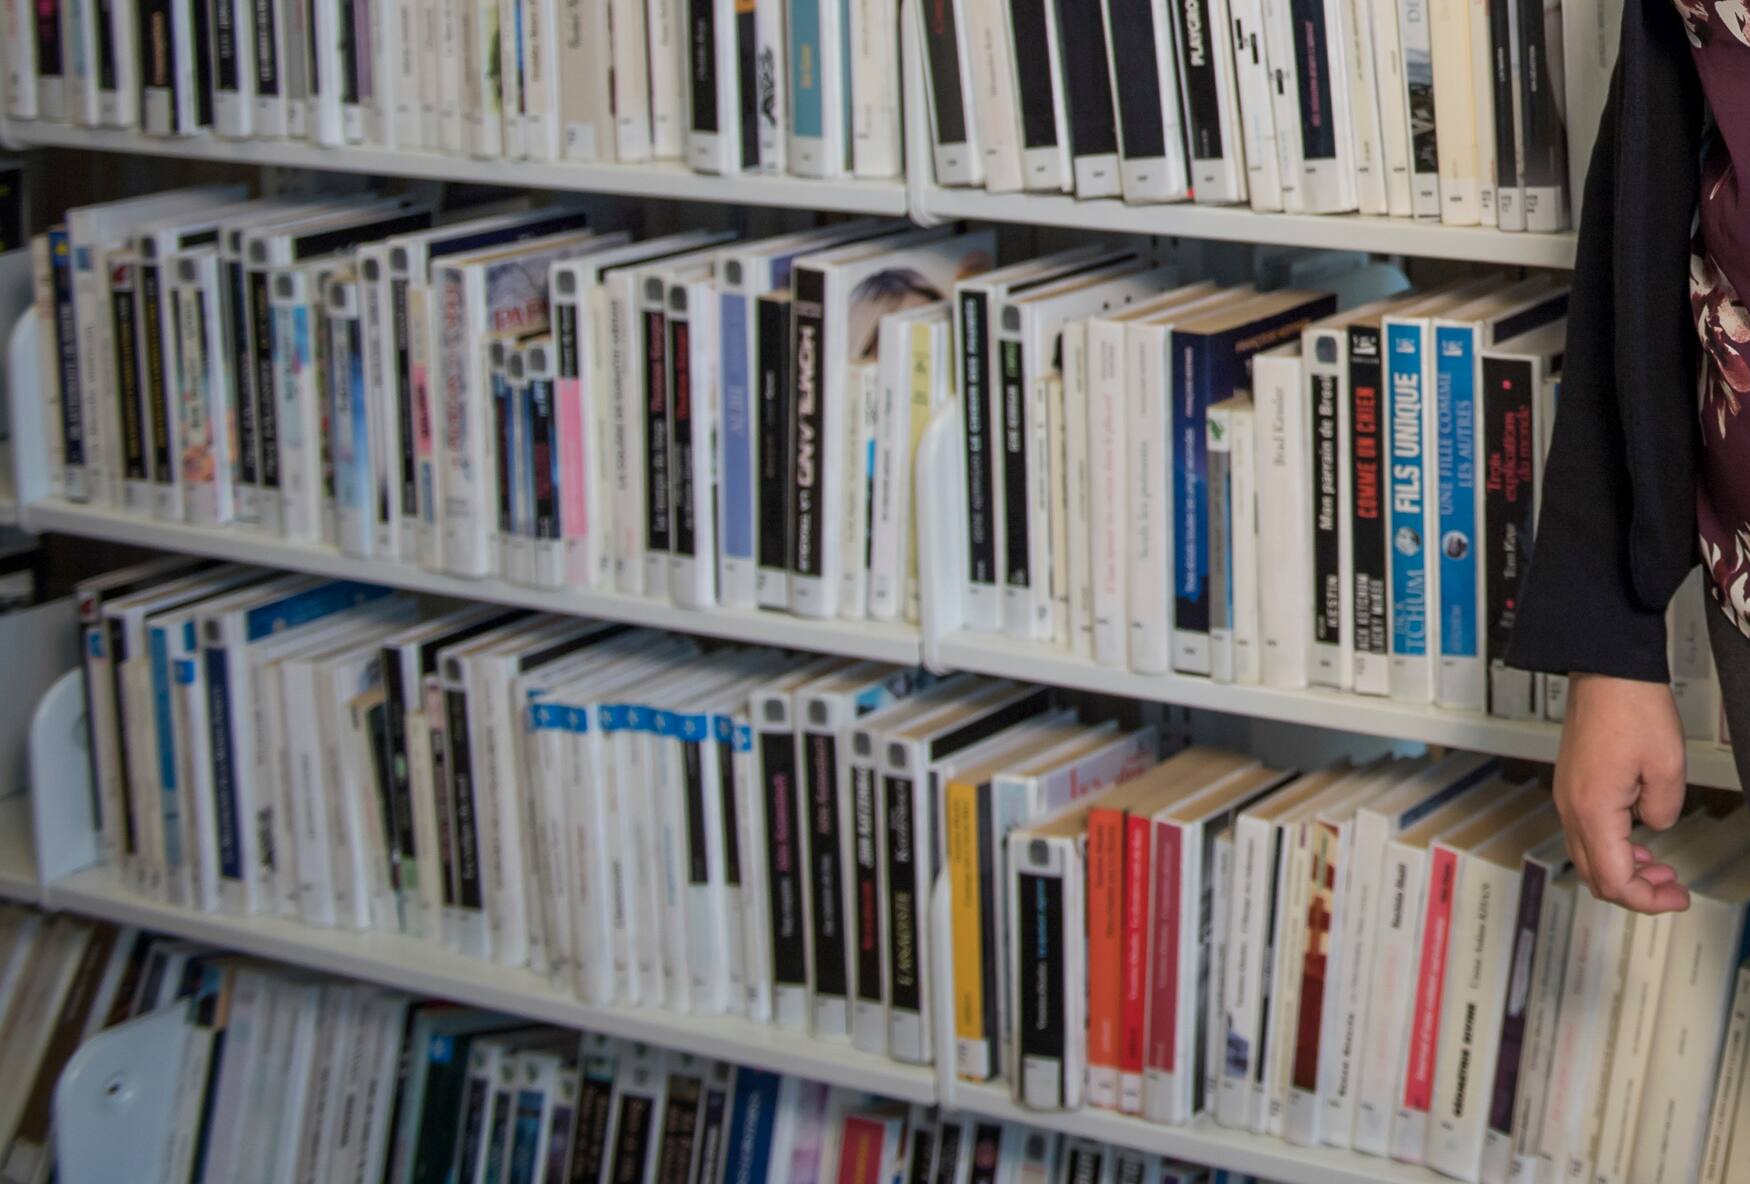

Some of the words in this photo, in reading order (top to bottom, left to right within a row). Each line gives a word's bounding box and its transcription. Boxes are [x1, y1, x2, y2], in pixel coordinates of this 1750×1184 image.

[1354, 386, 1376, 434] CHIEN
[1394, 372, 1421, 458] UNIQUE
[1438, 372, 1451, 431] COMME
[1318, 418, 1333, 438] de
[1356, 438, 1377, 458] UN
[1456, 400, 1472, 460] AUTRES
[1515, 404, 1530, 458] monde
[1319, 440, 1336, 502] parrain
[1438, 434, 1453, 476] FILLE
[1457, 463, 1472, 488] LES
[1487, 452, 1503, 491] Trois
[1502, 411, 1519, 503] explications
[1516, 460, 1531, 481] du
[1357, 461, 1377, 518] COMME
[1395, 465, 1421, 514] FILS
[1439, 480, 1453, 516] UNE
[1317, 504, 1334, 531] Mon
[1326, 574, 1339, 628] KESTIN
[1405, 569, 1425, 652] TCHUM
